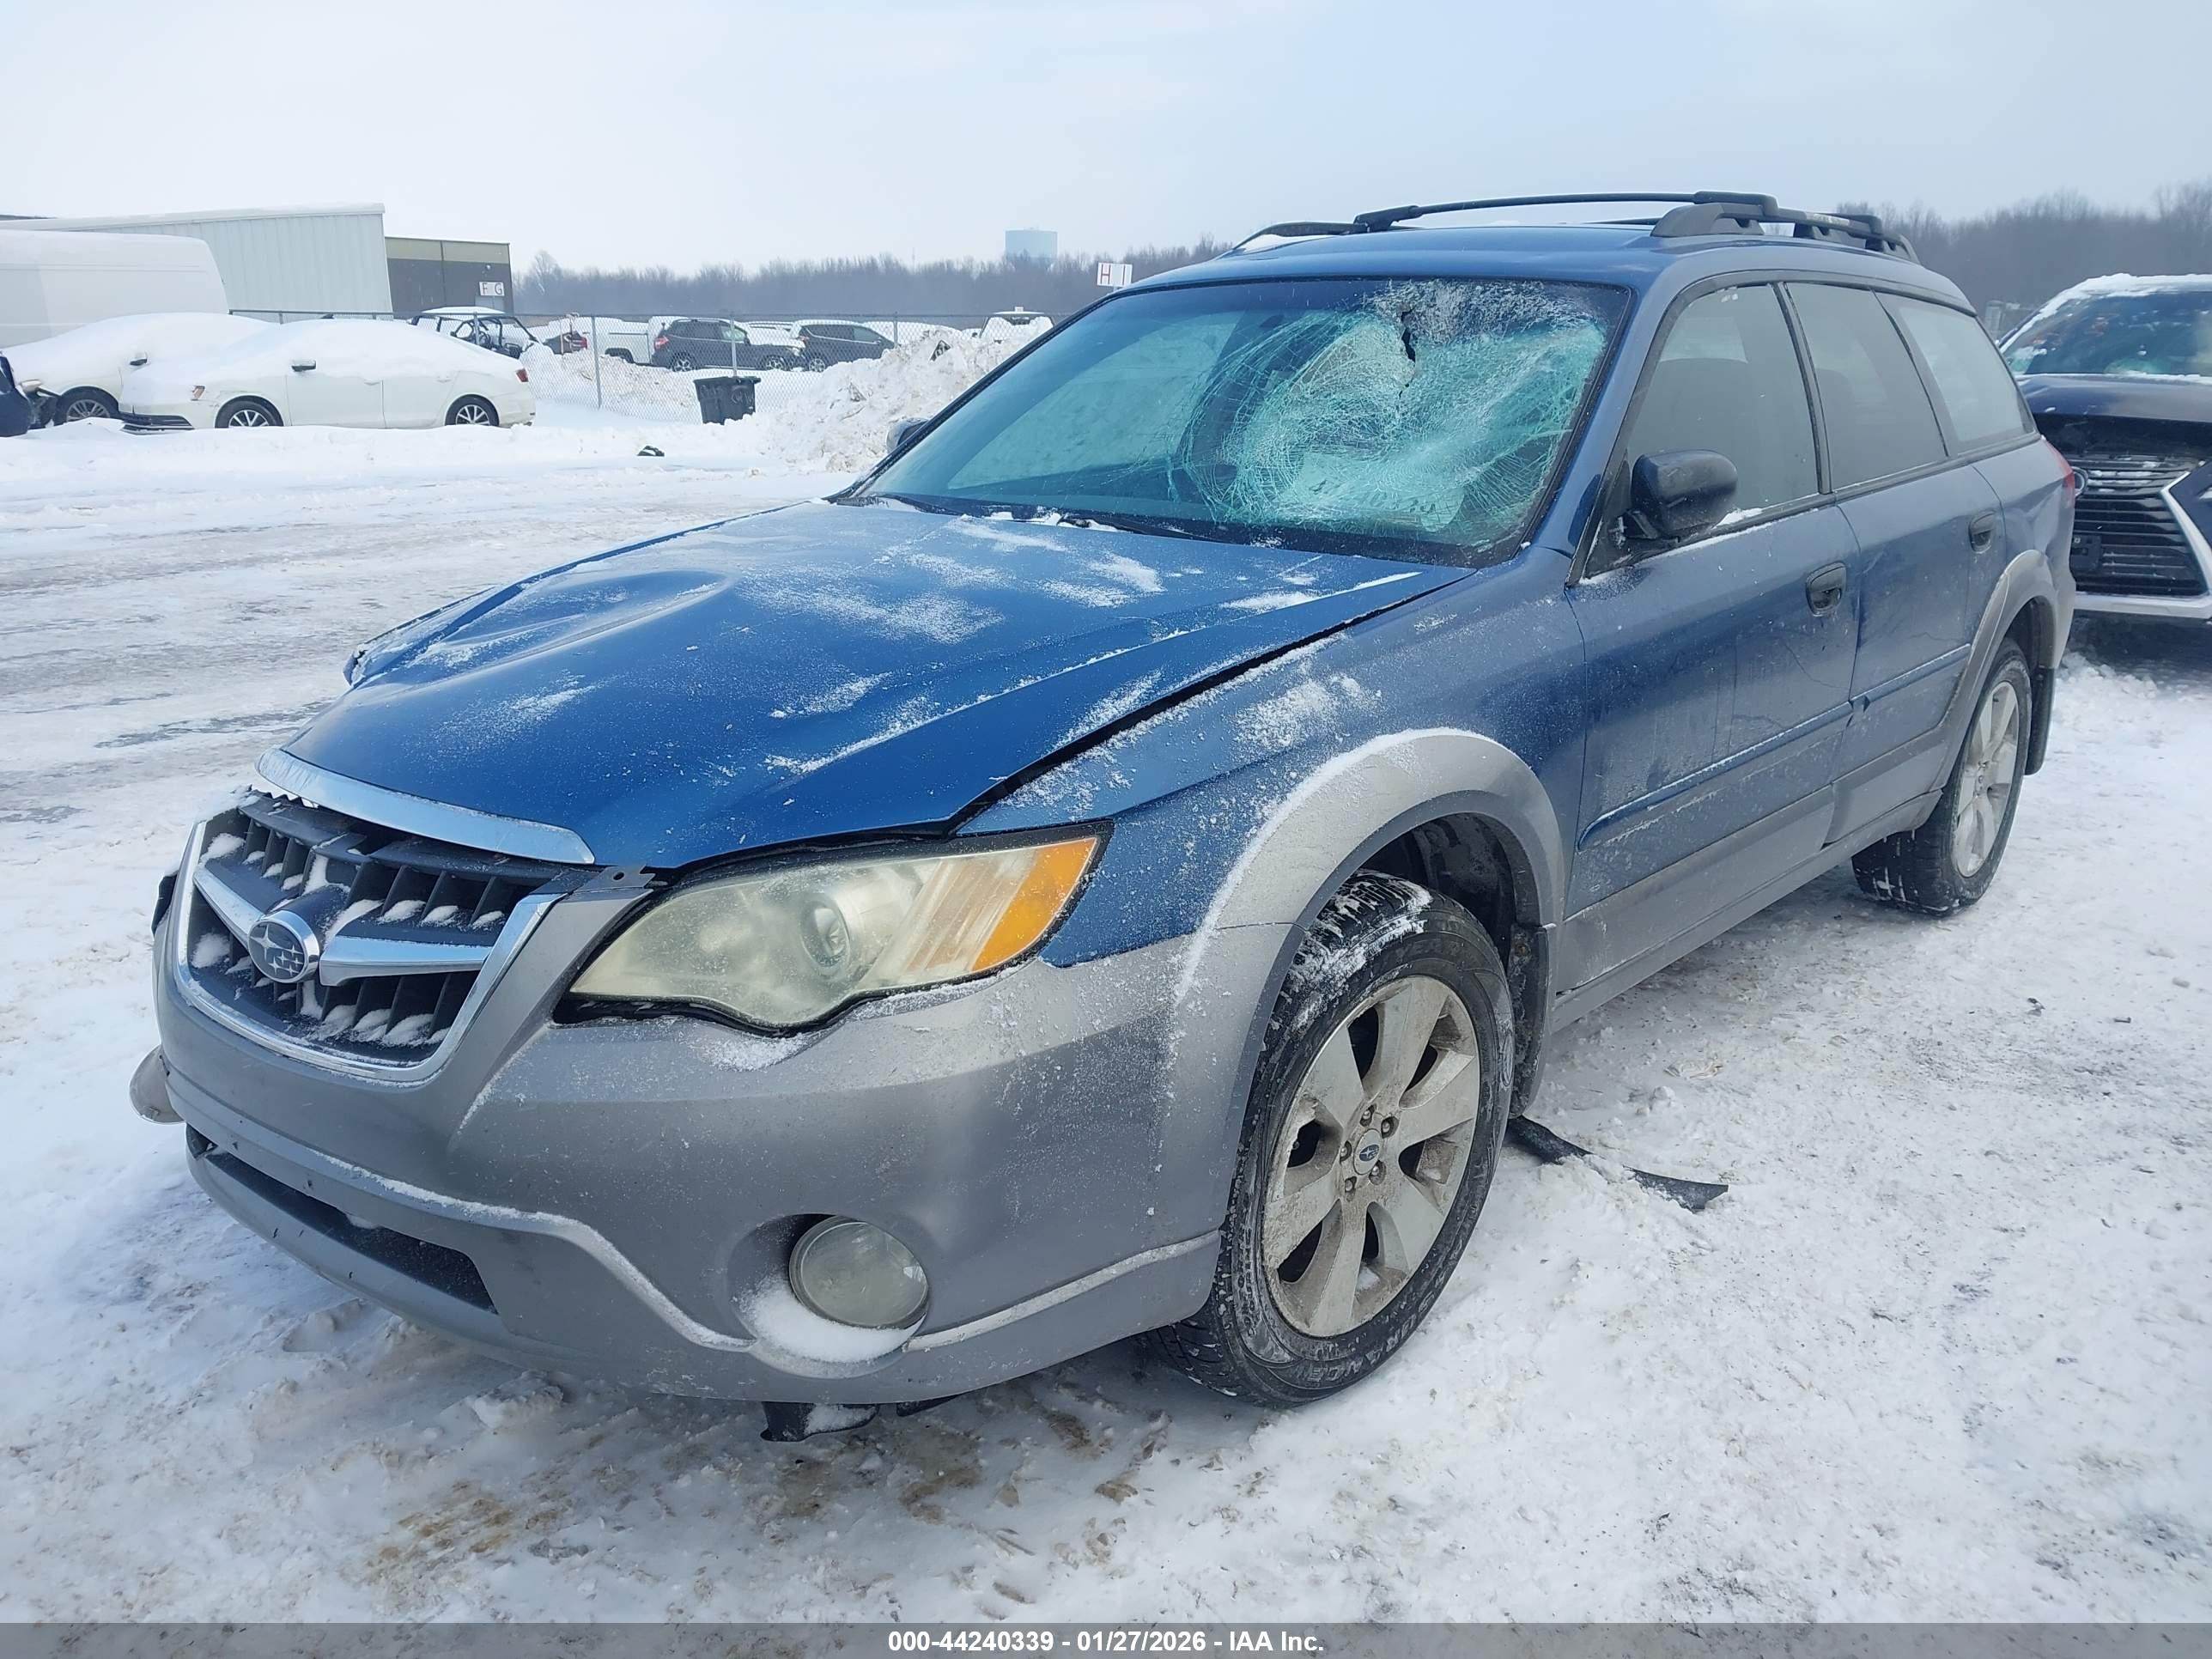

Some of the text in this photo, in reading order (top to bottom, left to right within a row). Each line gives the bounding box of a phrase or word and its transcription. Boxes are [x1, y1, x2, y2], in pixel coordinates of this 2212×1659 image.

[1100, 264, 1111, 285] H
[482, 282, 503, 295] F G
